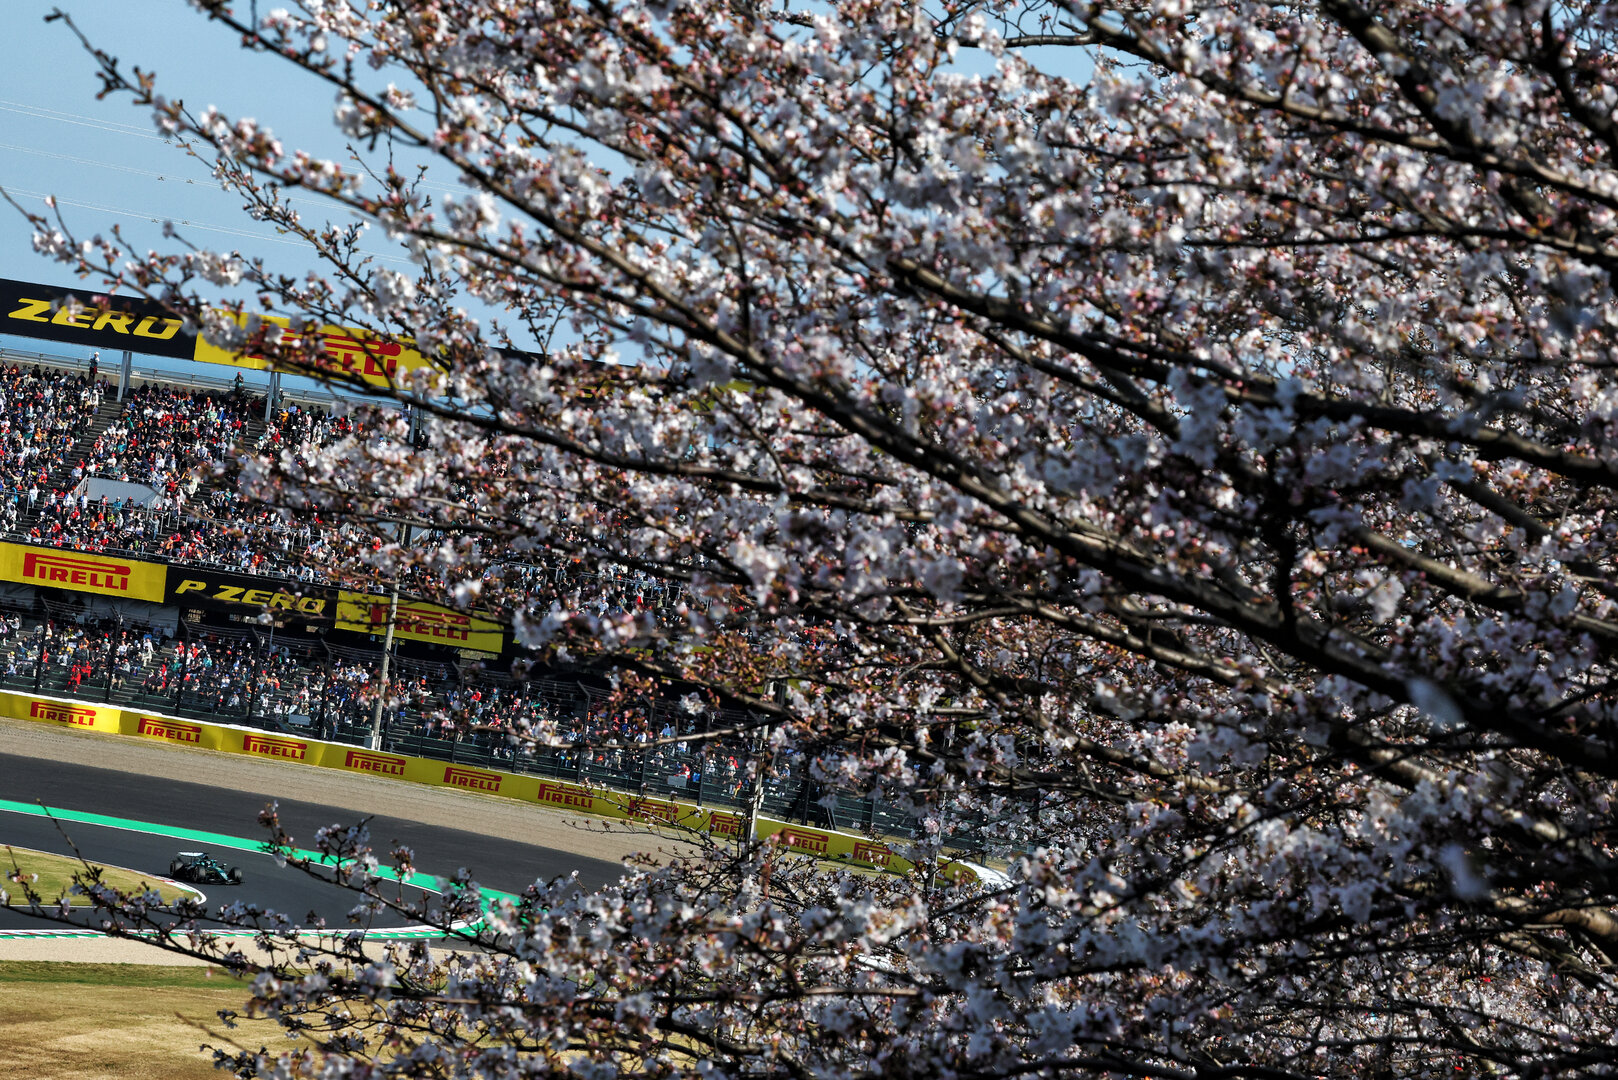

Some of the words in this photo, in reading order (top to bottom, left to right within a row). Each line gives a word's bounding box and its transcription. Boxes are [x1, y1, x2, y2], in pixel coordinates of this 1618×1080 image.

[8, 298, 184, 340] ZERO
[248, 324, 401, 379] PELLI
[23, 553, 131, 590] PIRELLI
[175, 579, 207, 594] P
[212, 585, 326, 614] ZERO
[370, 604, 470, 640] PRELLI
[30, 702, 96, 726] PIRELLI
[138, 718, 202, 743] PIRELLI
[243, 735, 307, 759] PIRELLI
[345, 751, 406, 776] PIRELLI
[443, 767, 502, 792] PIRELLI
[538, 783, 594, 809] PIRELLI
